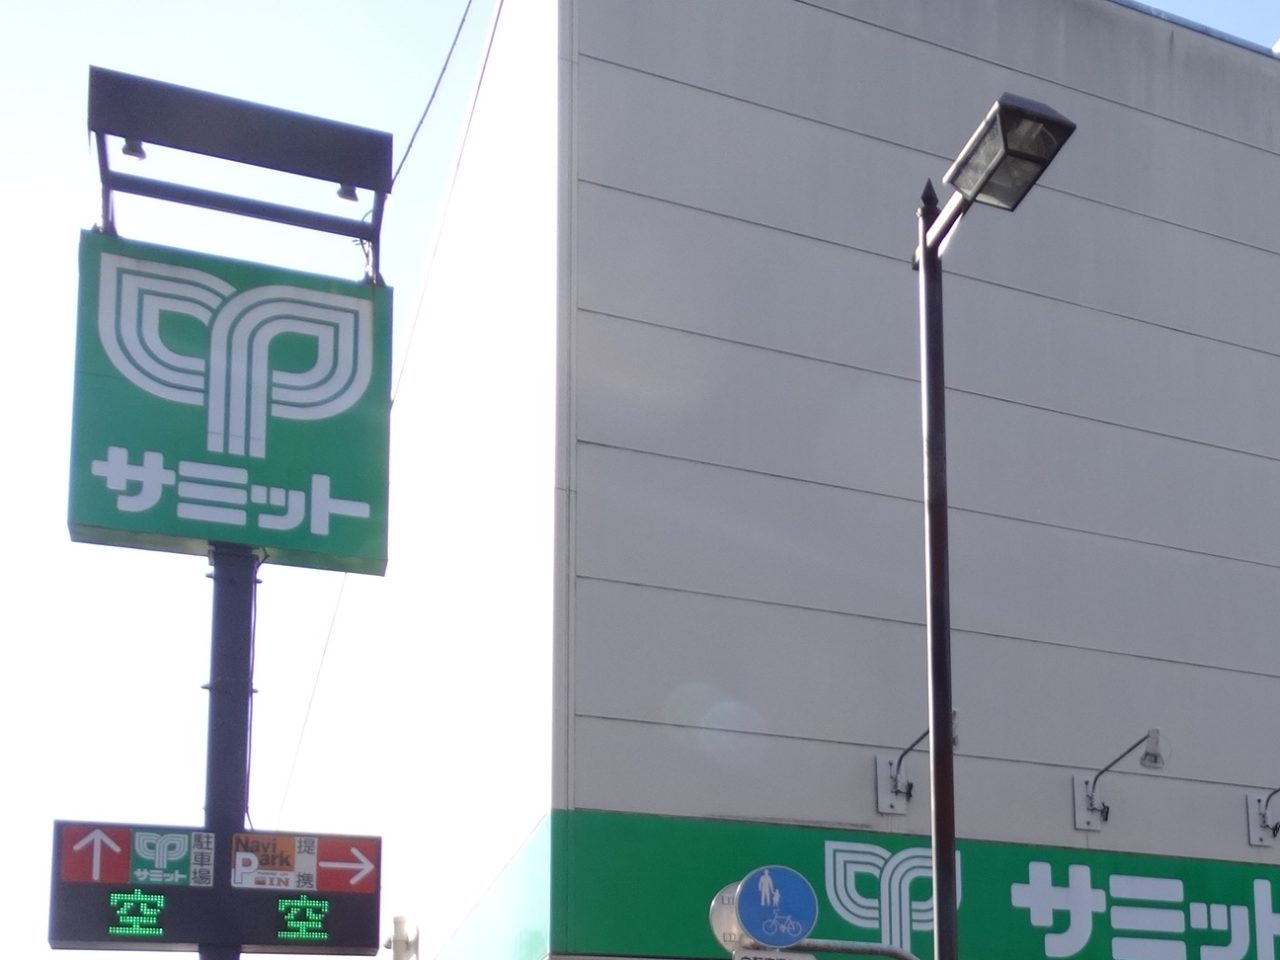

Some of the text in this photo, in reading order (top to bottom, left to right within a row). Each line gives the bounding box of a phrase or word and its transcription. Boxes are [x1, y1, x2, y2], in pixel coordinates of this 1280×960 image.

[91, 445, 370, 537] サミット
[192, 833, 214, 885] 駐車場
[235, 835, 276, 853] Navi
[235, 850, 291, 884] Park
[297, 837, 315, 889] 提携
[133, 868, 187, 883] サミット
[108, 888, 165, 937] 空
[277, 894, 330, 941] 空
